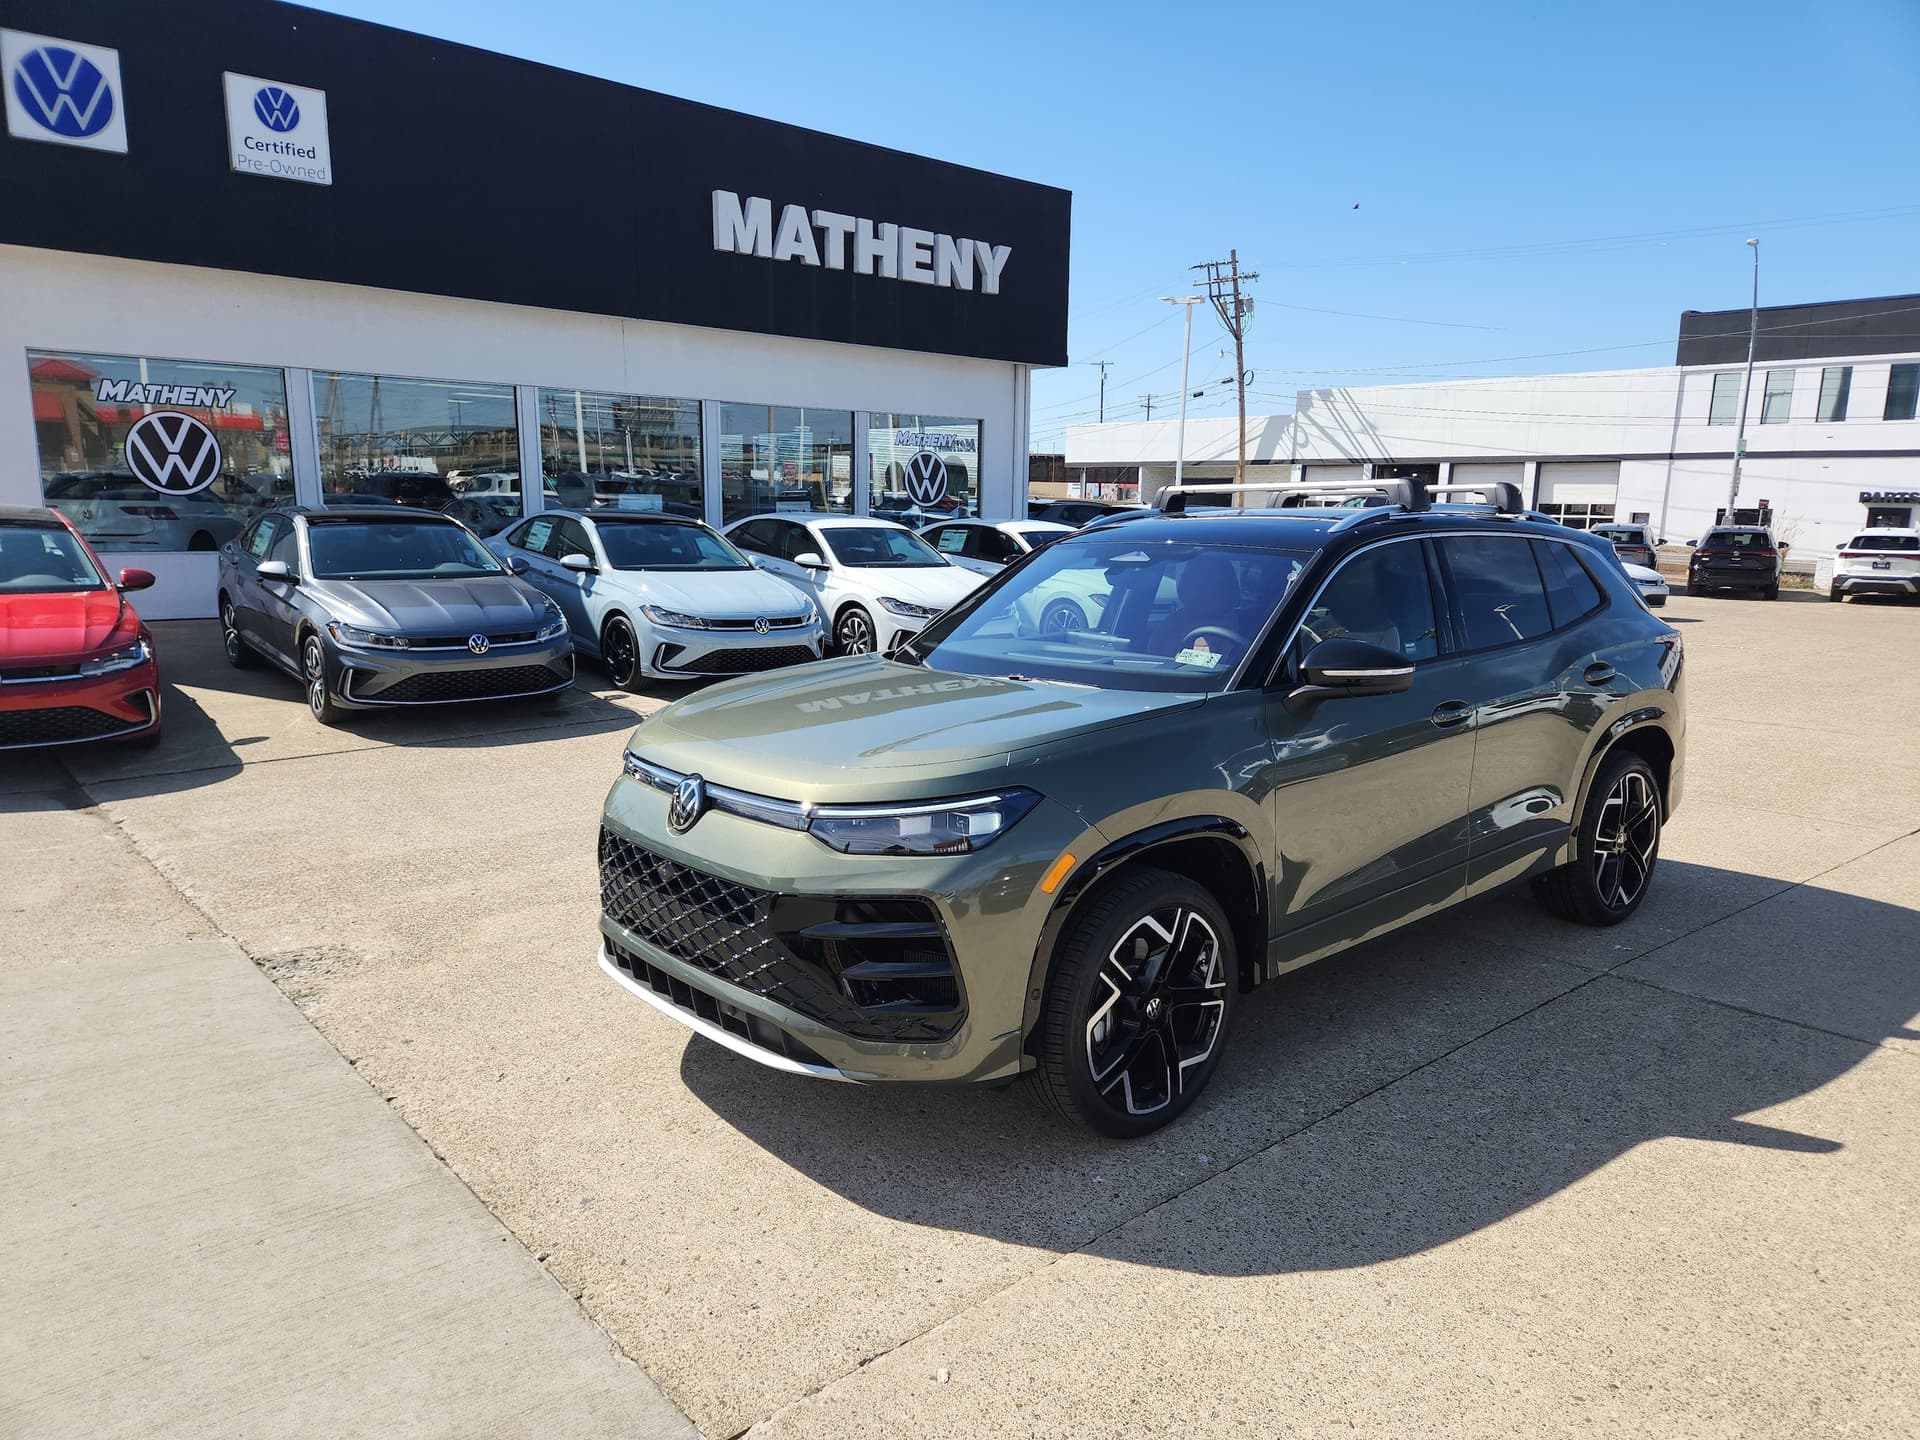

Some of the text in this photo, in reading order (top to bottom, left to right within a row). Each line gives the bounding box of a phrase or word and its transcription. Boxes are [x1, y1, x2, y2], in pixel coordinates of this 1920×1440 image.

[14, 46, 113, 137] VW
[254, 87, 300, 132] VW
[244, 136, 317, 160] Certified
[237, 153, 326, 180] Pre-Owned
[712, 189, 1012, 295] MATHENY
[97, 378, 237, 408] MATHENY
[124, 410, 222, 496] VW
[894, 430, 958, 449] MATHENY
[1859, 491, 1920, 504] PARTS
